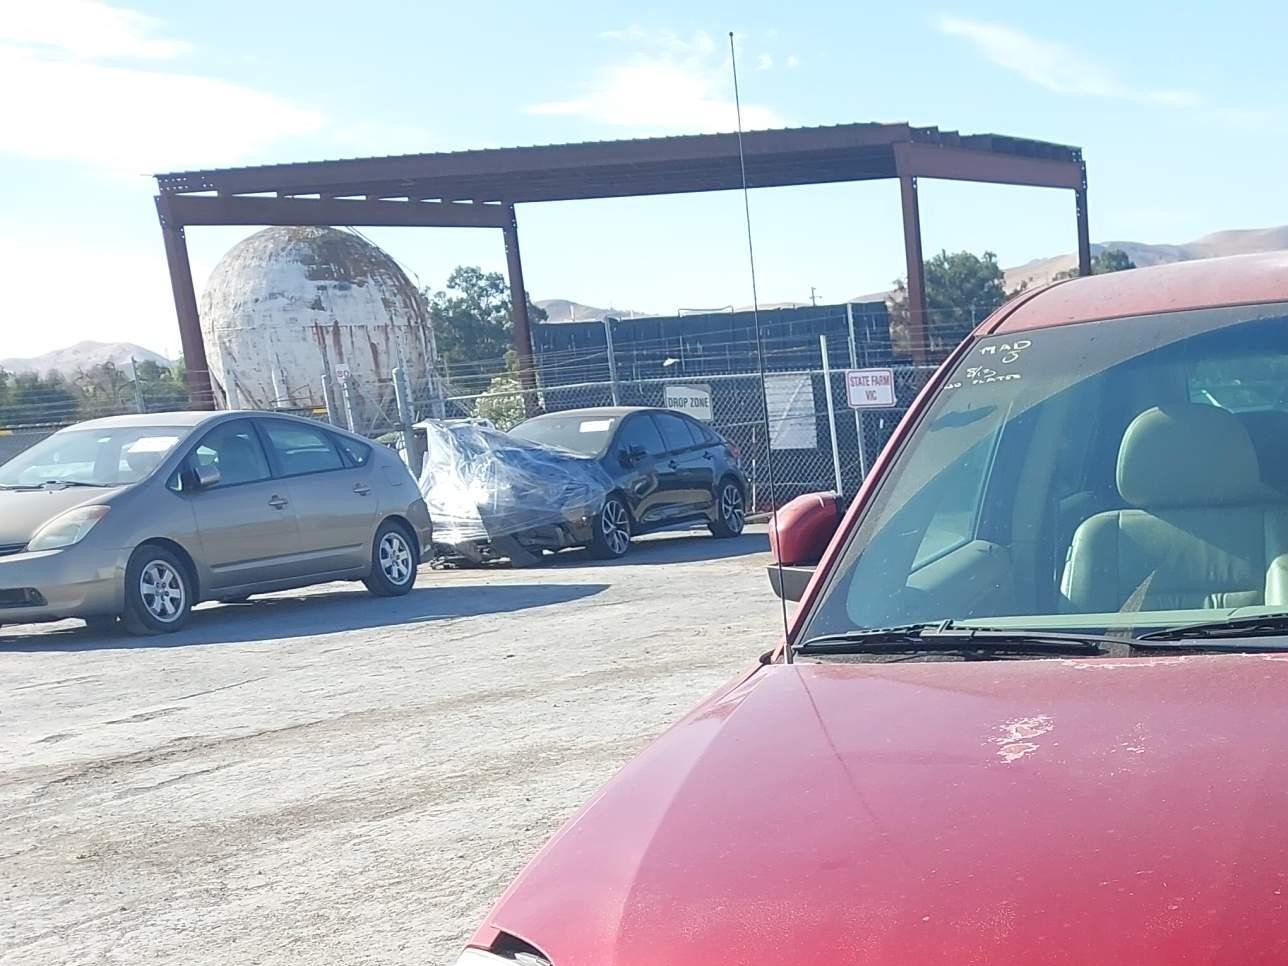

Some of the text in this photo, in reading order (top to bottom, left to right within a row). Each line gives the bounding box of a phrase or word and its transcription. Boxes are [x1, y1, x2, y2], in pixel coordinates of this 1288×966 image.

[980, 340, 1032, 355] MAD
[849, 375, 890, 387] STATE FARM
[864, 389, 878, 401] VIC
[667, 397, 710, 408] DROP ZONE
